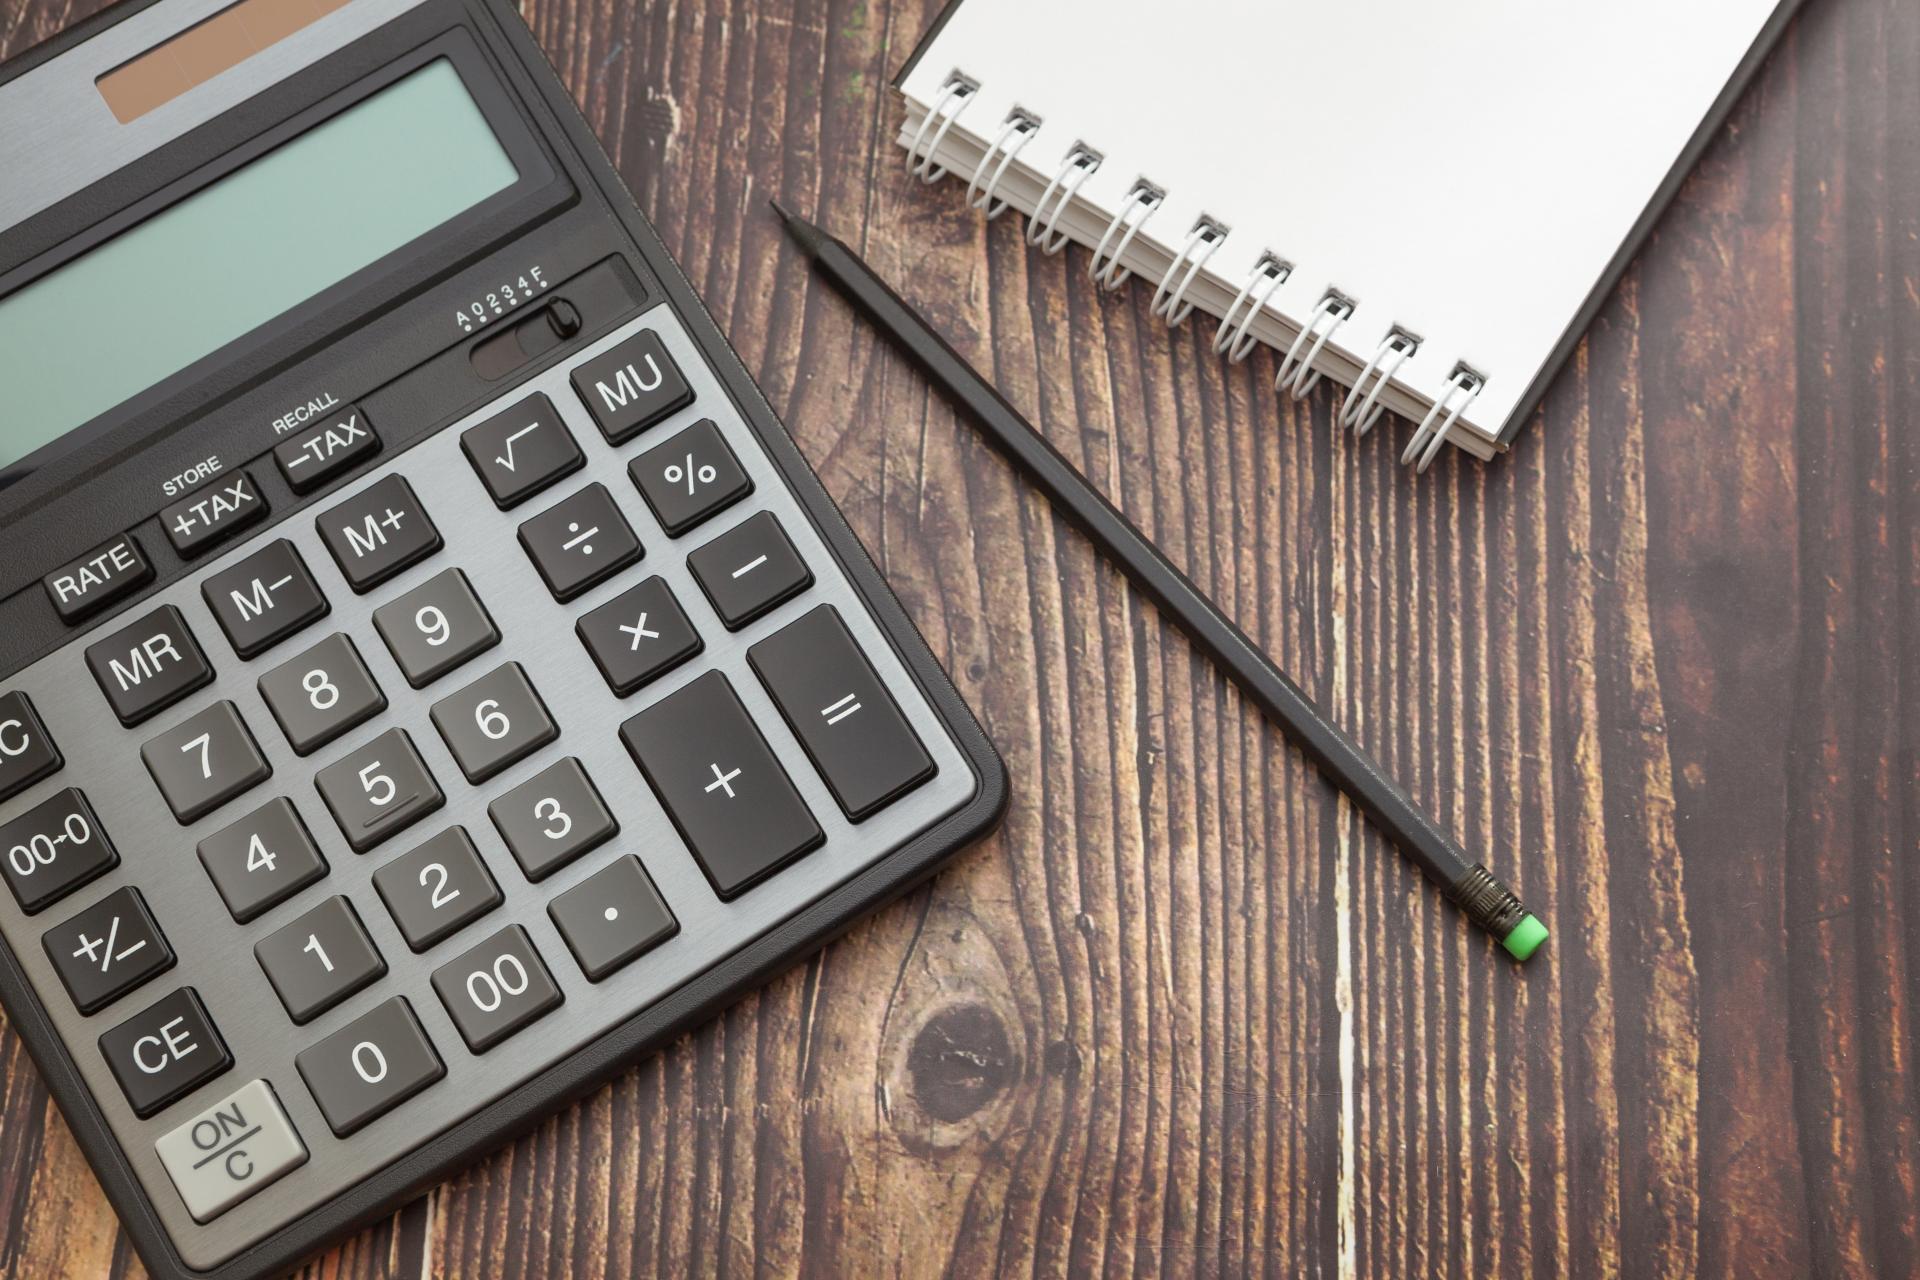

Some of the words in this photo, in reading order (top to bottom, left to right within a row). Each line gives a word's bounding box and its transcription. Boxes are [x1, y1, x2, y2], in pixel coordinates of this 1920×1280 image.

[595, 353, 663, 412] MU
[272, 391, 338, 435] RECALL
[162, 456, 223, 497] STORE
[664, 454, 716, 495] %
[173, 479, 253, 537] +TAX
[343, 509, 404, 557] M+
[53, 543, 136, 603] RATE
[416, 606, 450, 645] 9
[108, 633, 182, 691] MR
[303, 670, 339, 709] 8
[476, 700, 509, 739] 6
[0, 720, 29, 764] C
[181, 733, 211, 778] 7
[359, 761, 395, 805] 5
[535, 798, 571, 839] 3
[247, 834, 276, 872] 4
[420, 863, 460, 908] 2
[304, 934, 334, 971] 1
[466, 954, 529, 1012] 00
[132, 1016, 198, 1074] CE
[352, 1042, 387, 1083] 0
[191, 1102, 248, 1150] ON
[226, 1150, 254, 1181] C
